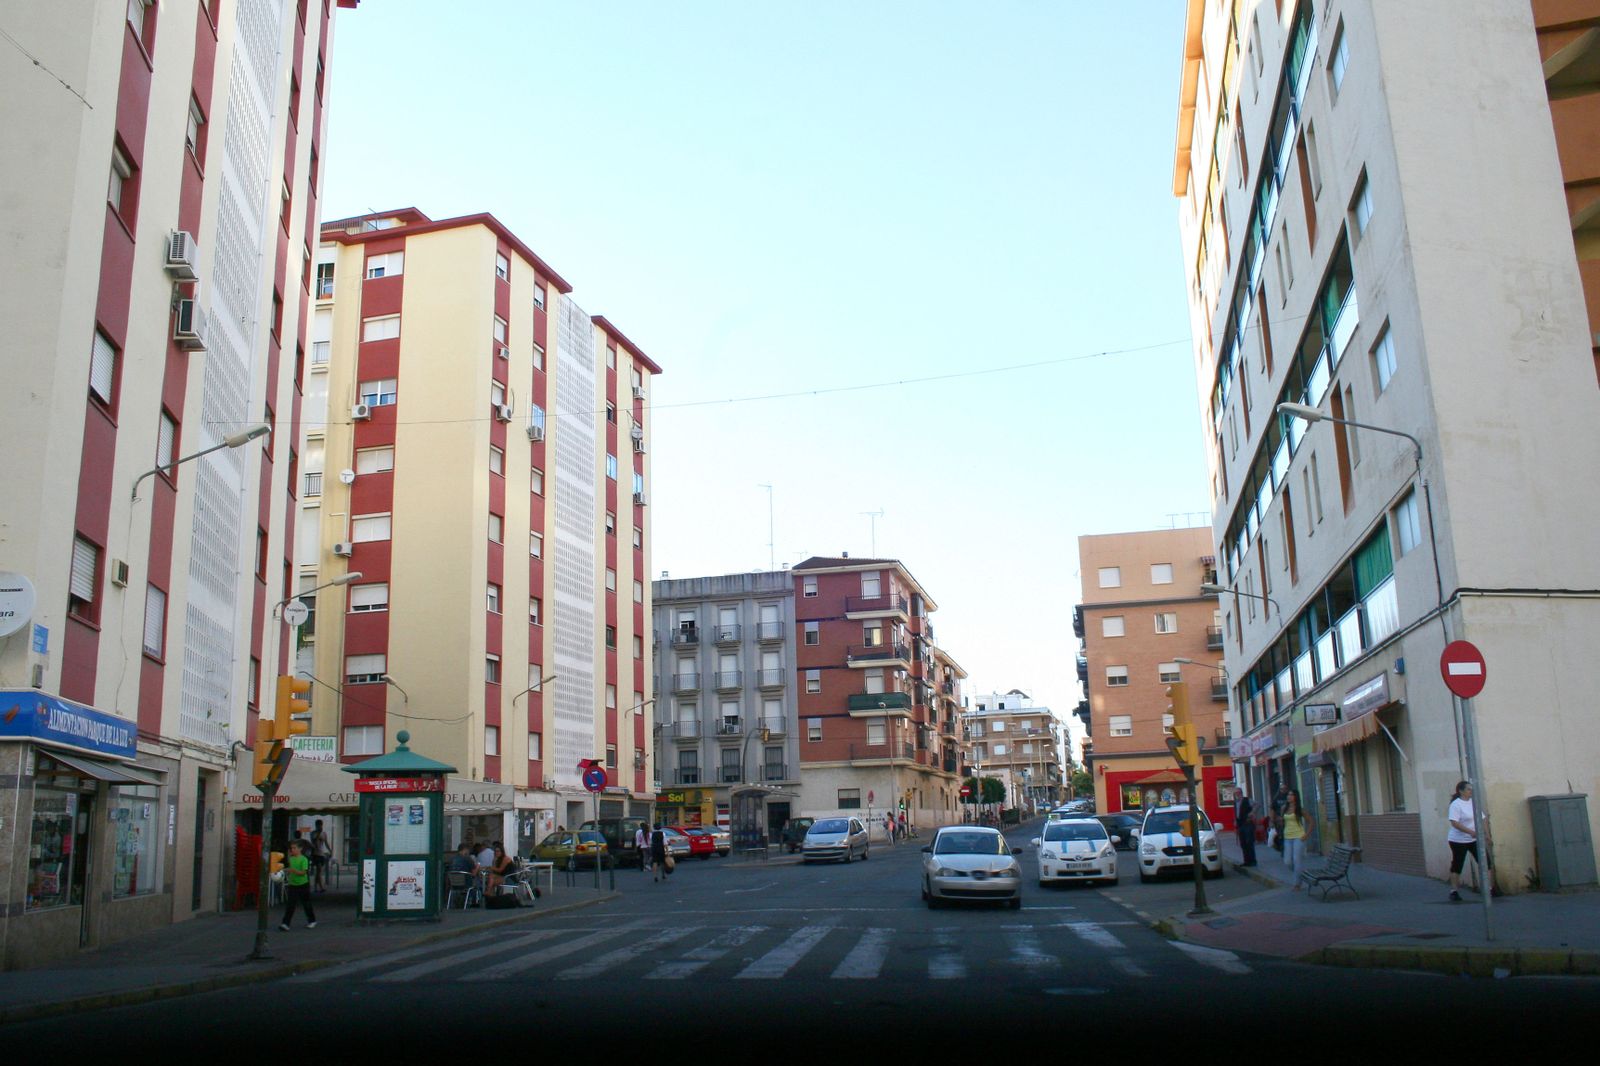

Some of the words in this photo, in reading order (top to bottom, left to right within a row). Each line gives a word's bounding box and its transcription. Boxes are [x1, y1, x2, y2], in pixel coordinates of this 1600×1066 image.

[293, 738, 334, 751] CAFETERIA
[462, 793, 477, 803] LA
[481, 793, 503, 803] LUZ
